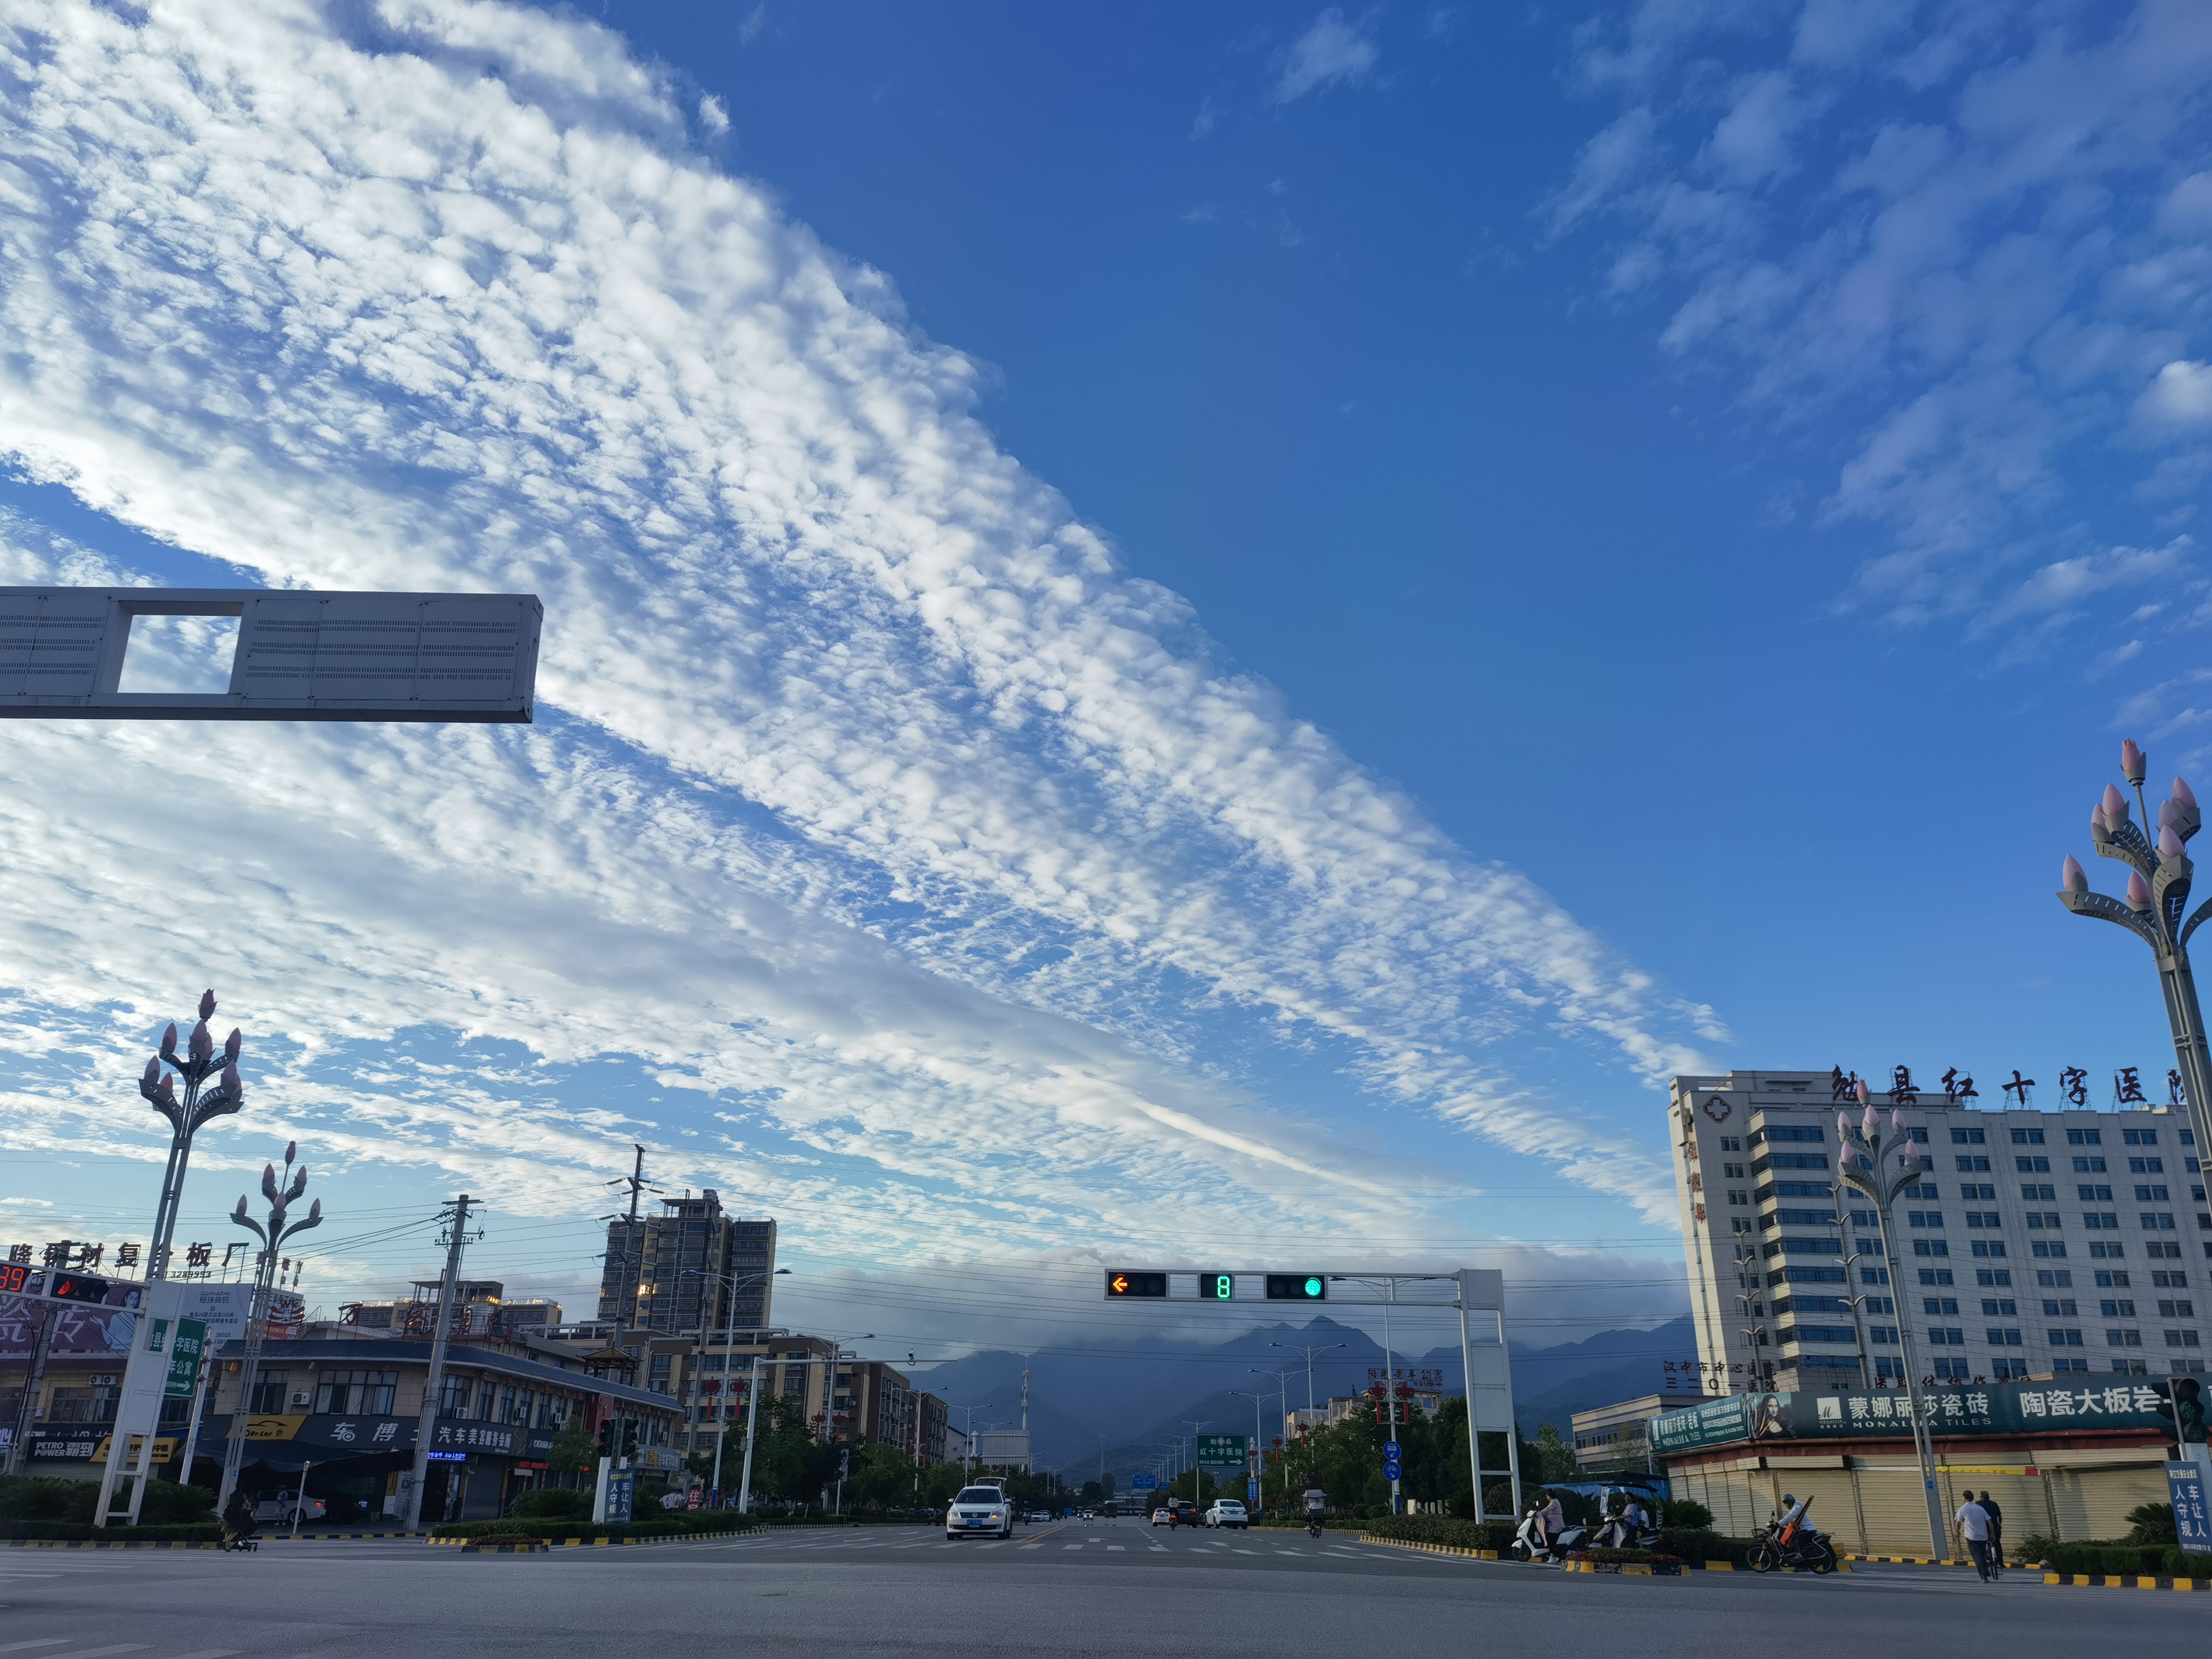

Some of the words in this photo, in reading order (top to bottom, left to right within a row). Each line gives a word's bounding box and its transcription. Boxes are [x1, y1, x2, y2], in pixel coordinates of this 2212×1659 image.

[1218, 1276, 1230, 1297] 8
[151, 1331, 199, 1354] 县字医院
[2019, 1385, 2172, 1418] 陶瓷大板岩
[1946, 1418, 1991, 1426] TILES
[1199, 1447, 1243, 1456] 红十字医院
[609, 1482, 618, 1514] 人守规
[620, 1482, 630, 1513] 车让人
[2175, 1484, 2193, 1537] 人守规
[2188, 1485, 2207, 1537] 车让人
